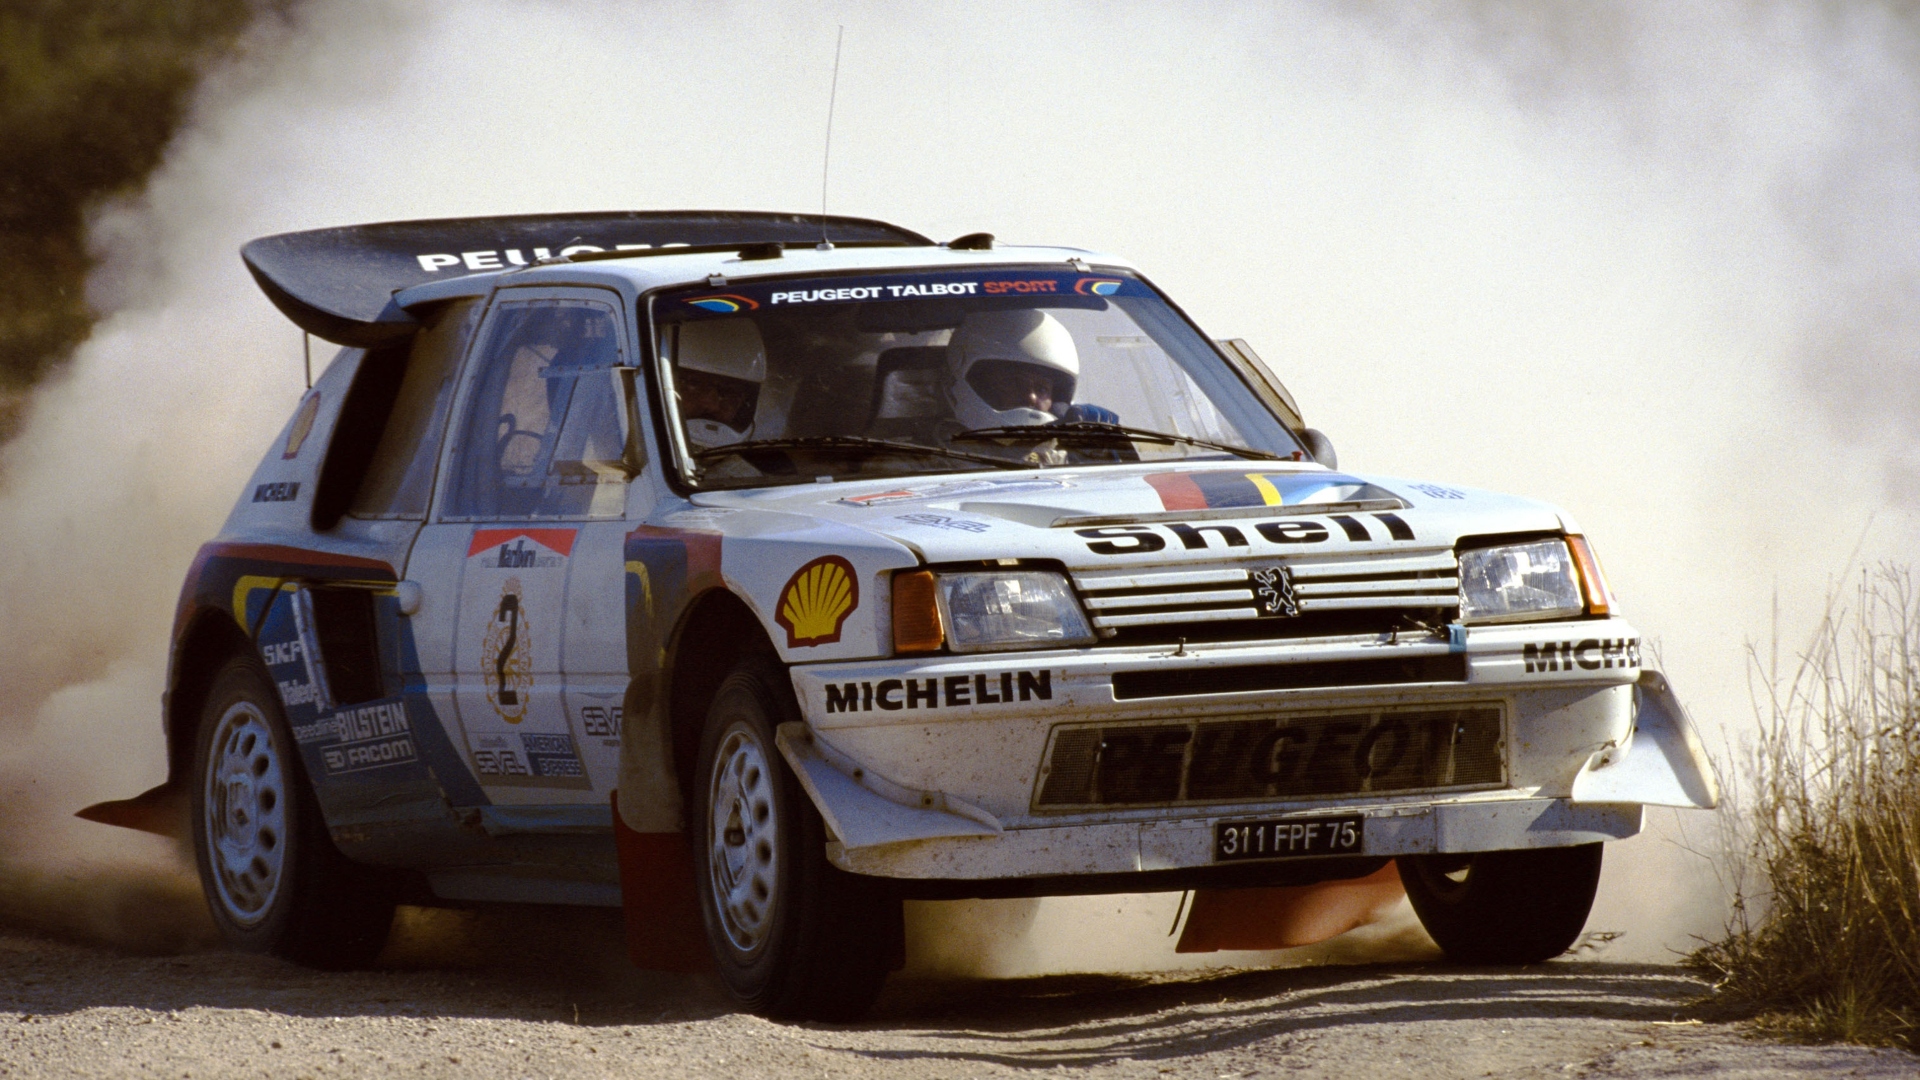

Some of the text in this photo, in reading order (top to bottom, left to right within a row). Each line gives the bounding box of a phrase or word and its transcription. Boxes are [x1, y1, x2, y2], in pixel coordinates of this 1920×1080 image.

[771, 279, 1058, 304] PEUGEOT TALBOT SPORT
[1074, 513, 1415, 555] Shell
[497, 594, 519, 705] 2
[825, 669, 1052, 714] MICHELIN
[335, 702, 409, 742] BILSTEIN
[348, 740, 412, 766] FACOM
[522, 734, 574, 753] AMERICAN
[1223, 821, 1356, 855] 311 FPF 75
